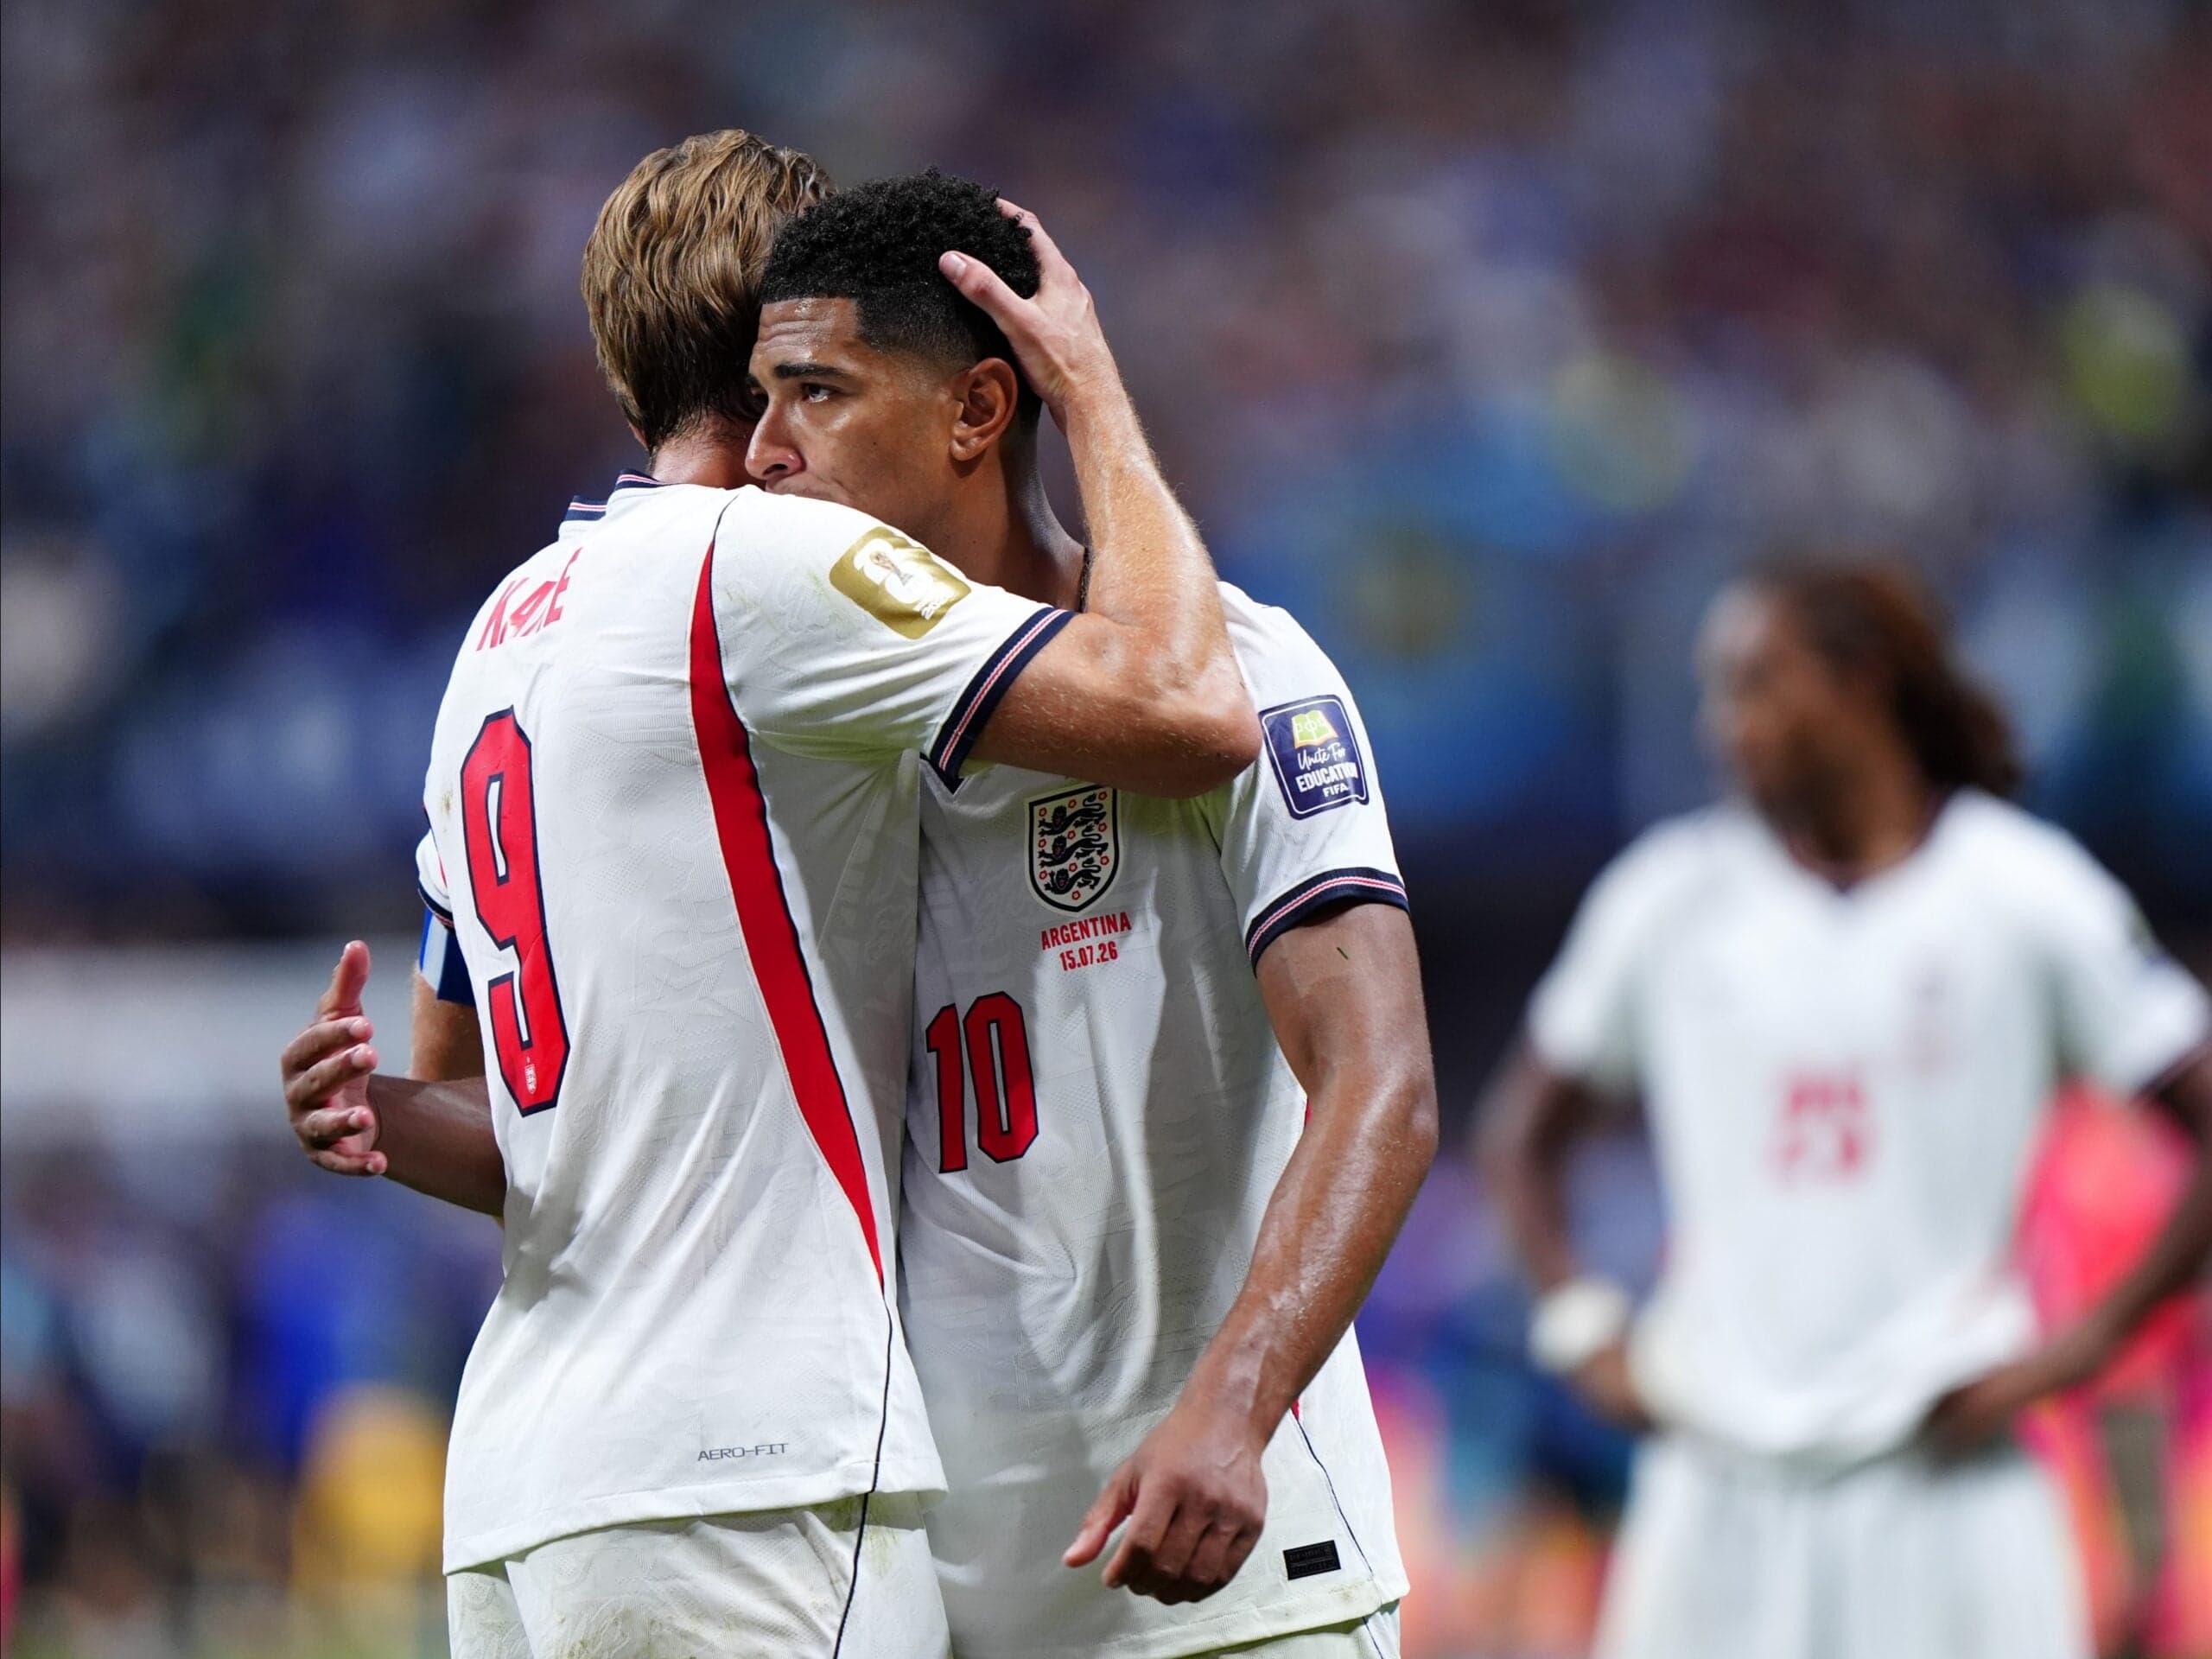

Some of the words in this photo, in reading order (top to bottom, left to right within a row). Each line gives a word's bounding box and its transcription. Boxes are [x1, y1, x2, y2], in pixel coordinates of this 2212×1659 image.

[1297, 747, 1331, 771] Unite
[1328, 742, 1346, 761] For
[1322, 783, 1349, 798] FIFA
[460, 704, 570, 1118] 9
[1040, 912, 1132, 950] ARGENTINA
[1059, 941, 1118, 971] 15.07.26
[925, 990, 1039, 1173] 10
[697, 1442, 790, 1462] AERO-FIT
